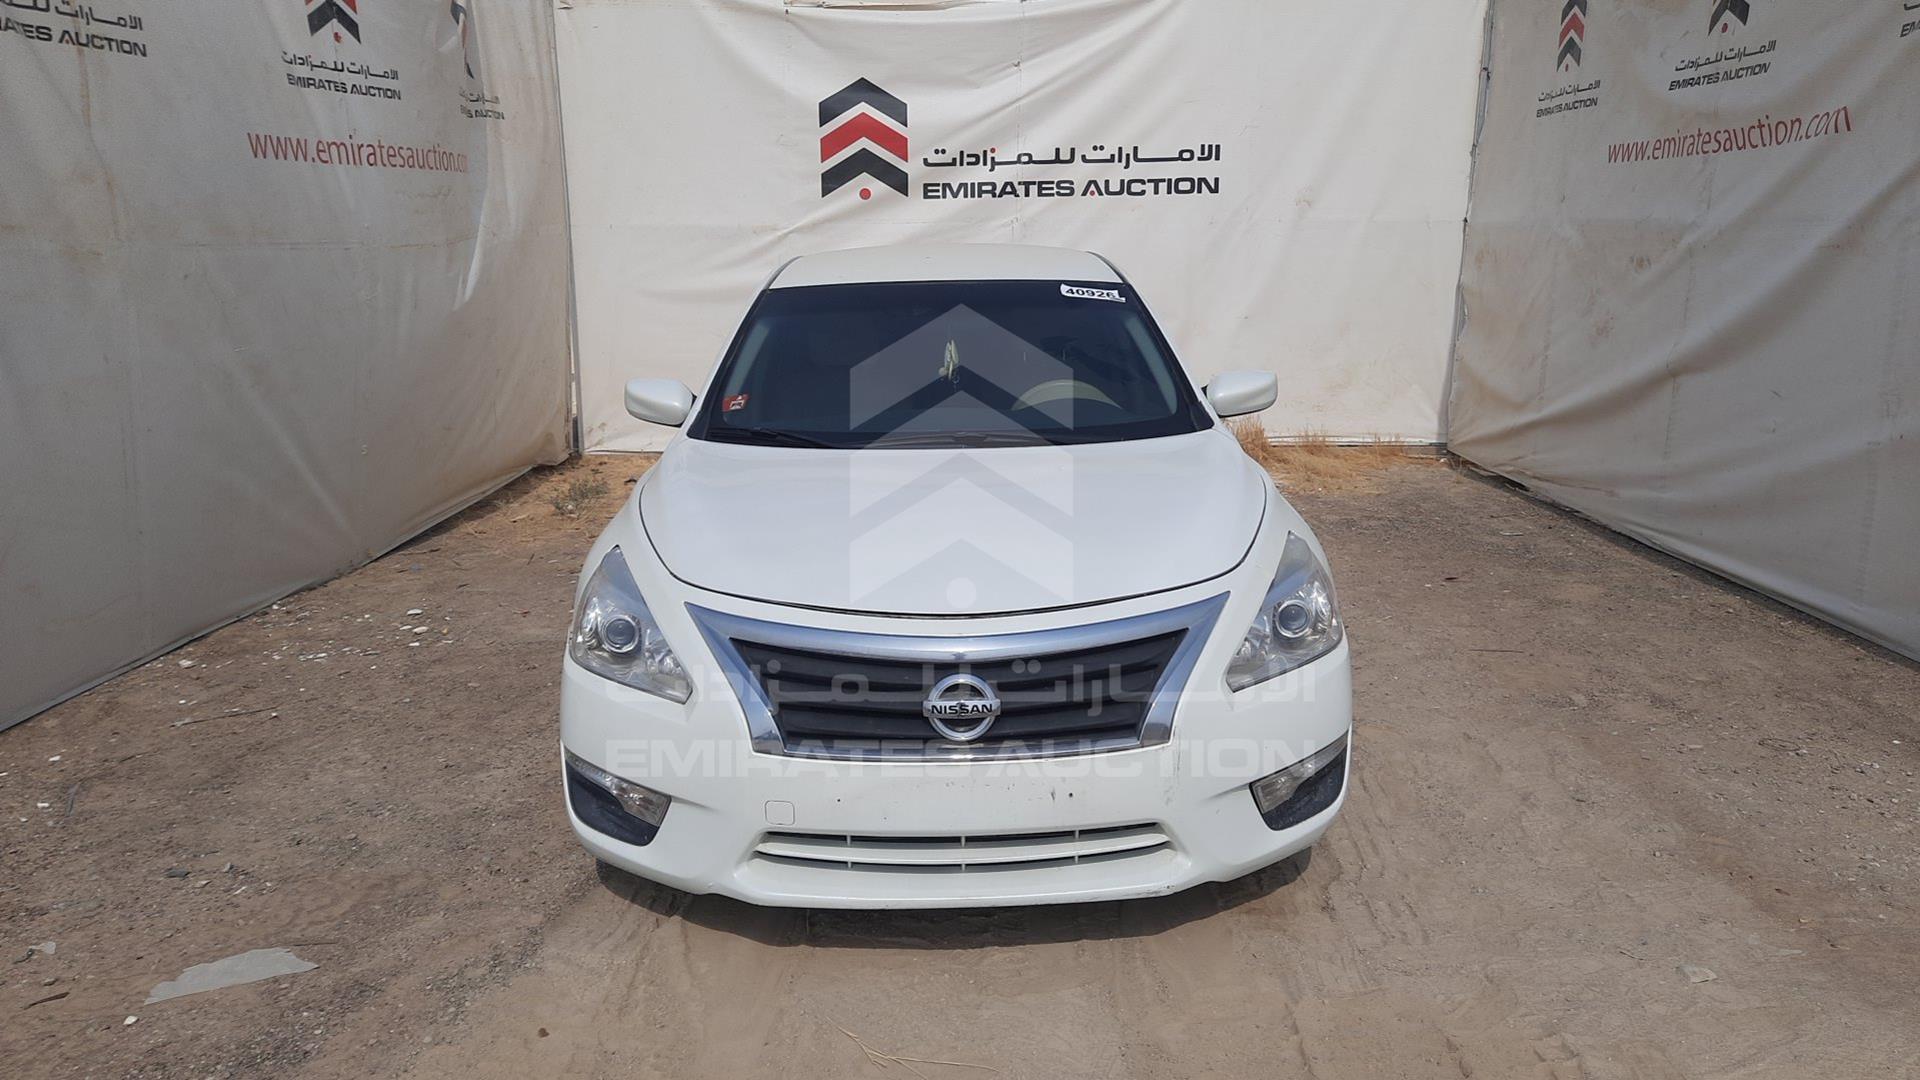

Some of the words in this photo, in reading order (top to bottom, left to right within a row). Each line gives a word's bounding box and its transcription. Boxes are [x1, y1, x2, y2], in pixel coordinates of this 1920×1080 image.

[58, 30, 148, 58] AUCTION
[286, 73, 348, 94] EMIRATES
[350, 83, 401, 101] AUCTION
[1668, 71, 1720, 91] EMIRATES
[1720, 61, 1772, 81] AUCTION
[1563, 97, 1599, 112] AUCTION
[1607, 105, 1852, 164] www.emiratesauction.com
[923, 180, 1075, 199] EMIRATES
[1081, 177, 1219, 197] AUCTION
[931, 703, 993, 715] NISSAN
